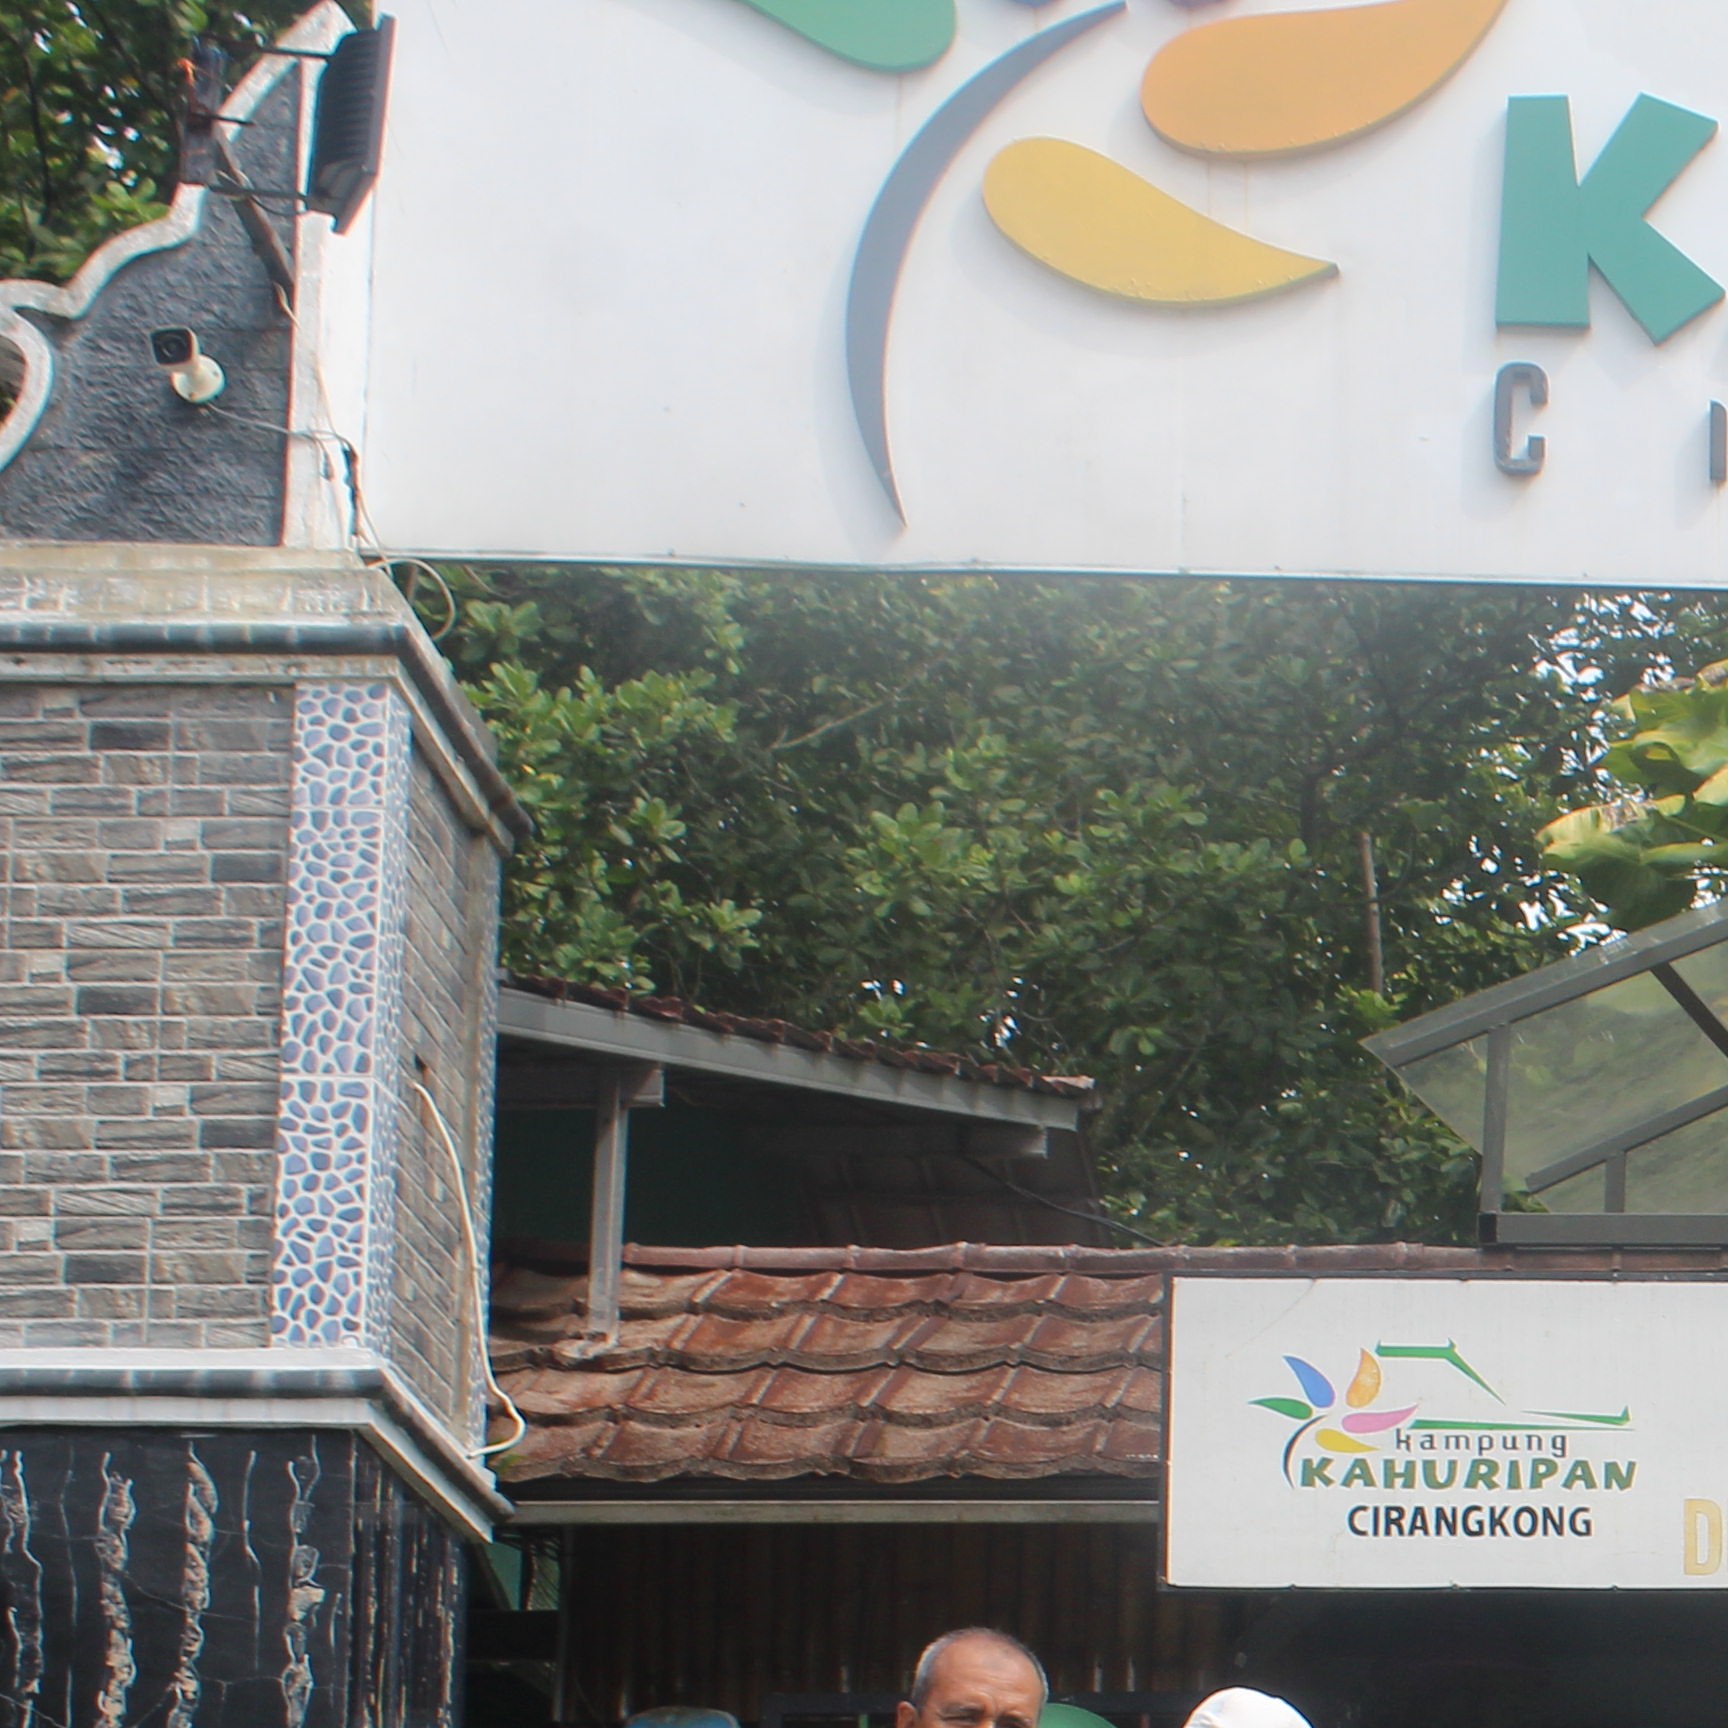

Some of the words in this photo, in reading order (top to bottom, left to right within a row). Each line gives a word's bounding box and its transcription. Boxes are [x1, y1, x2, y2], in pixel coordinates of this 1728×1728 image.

[1396, 1427, 1568, 1459] kampung
[1301, 1457, 1634, 1490] KAHURIPAN
[1348, 1505, 1592, 1538] CIRANGKONG
